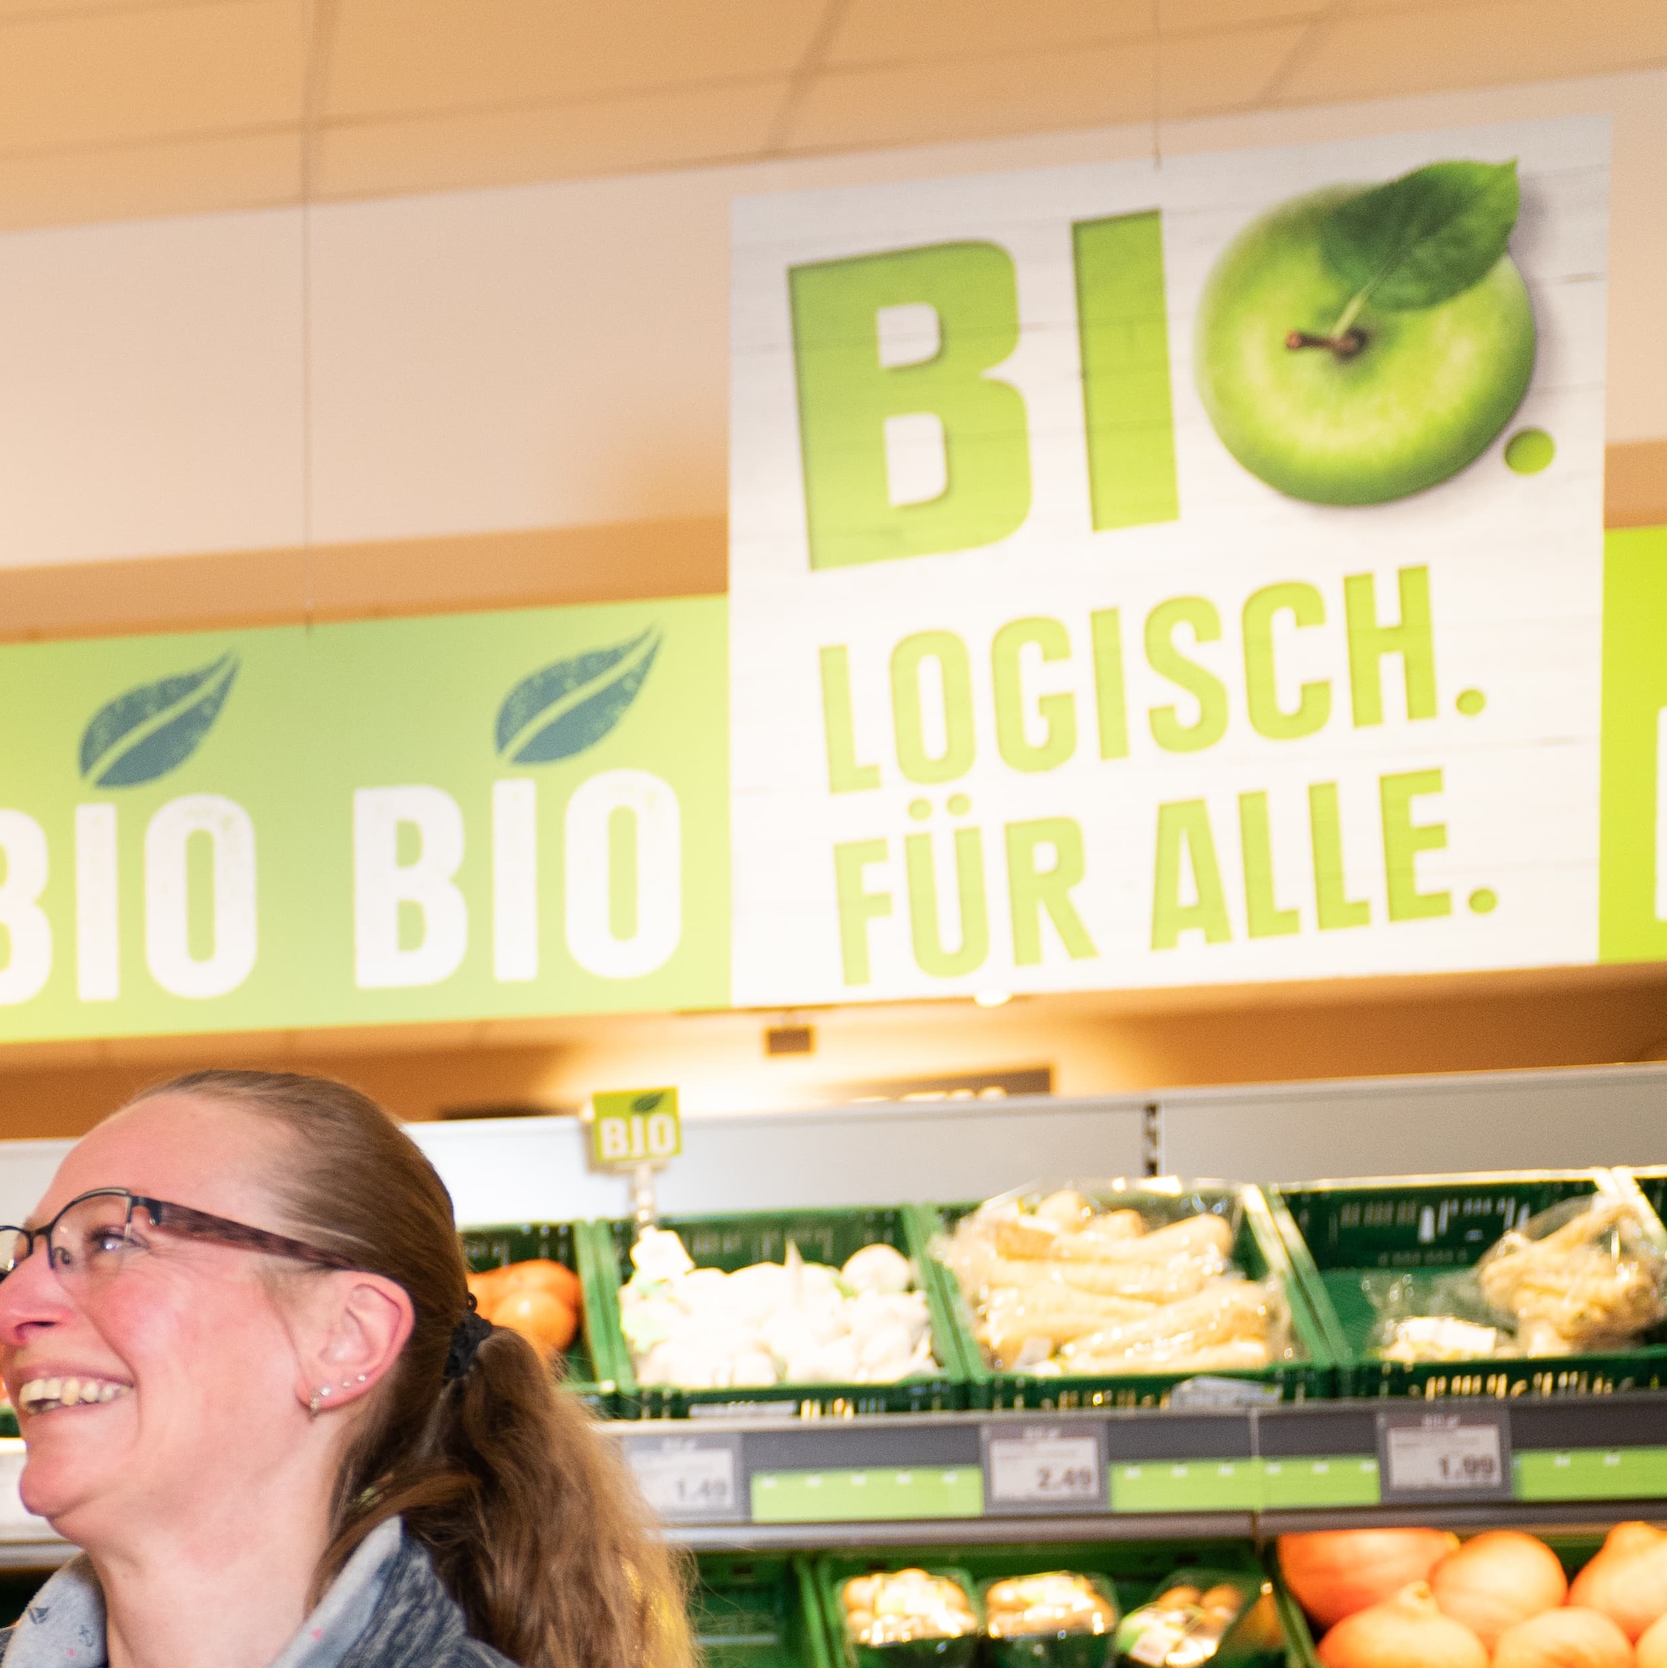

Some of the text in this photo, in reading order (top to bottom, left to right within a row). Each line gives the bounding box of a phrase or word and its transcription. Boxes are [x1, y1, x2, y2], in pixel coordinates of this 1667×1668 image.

[818, 563, 1487, 794] LOGISCH.
[352, 768, 682, 989] BIO
[832, 792, 1099, 988] FÜR
[1150, 767, 1498, 952] ALLE.
[600, 1113, 677, 1158] BIO
[1036, 1466, 1093, 1490] 2.49
[1438, 1454, 1495, 1479] 1.99
